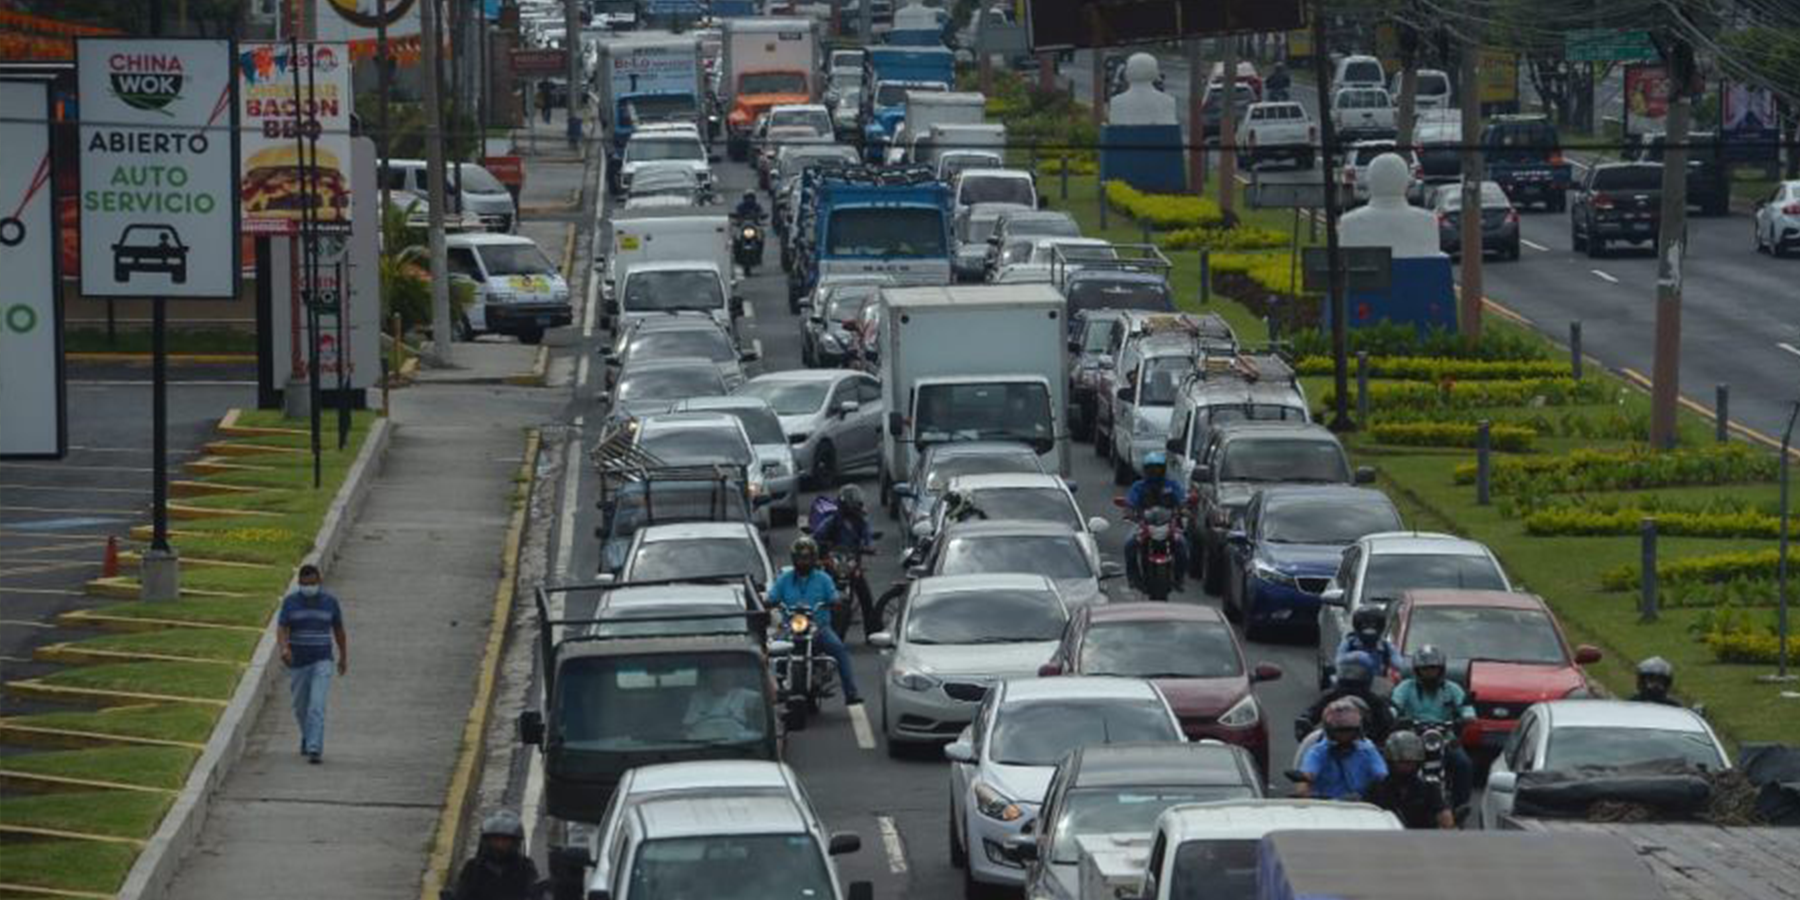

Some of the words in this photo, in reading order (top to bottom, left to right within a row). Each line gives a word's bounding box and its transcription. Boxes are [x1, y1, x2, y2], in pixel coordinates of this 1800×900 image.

[109, 53, 183, 72] CHINA
[118, 76, 176, 94] WOK
[246, 99, 338, 117] BACON
[263, 120, 322, 140] BBQ
[89, 132, 208, 154] ABIERTO
[110, 165, 188, 187] AUTO
[84, 191, 216, 213] SERVICIO
